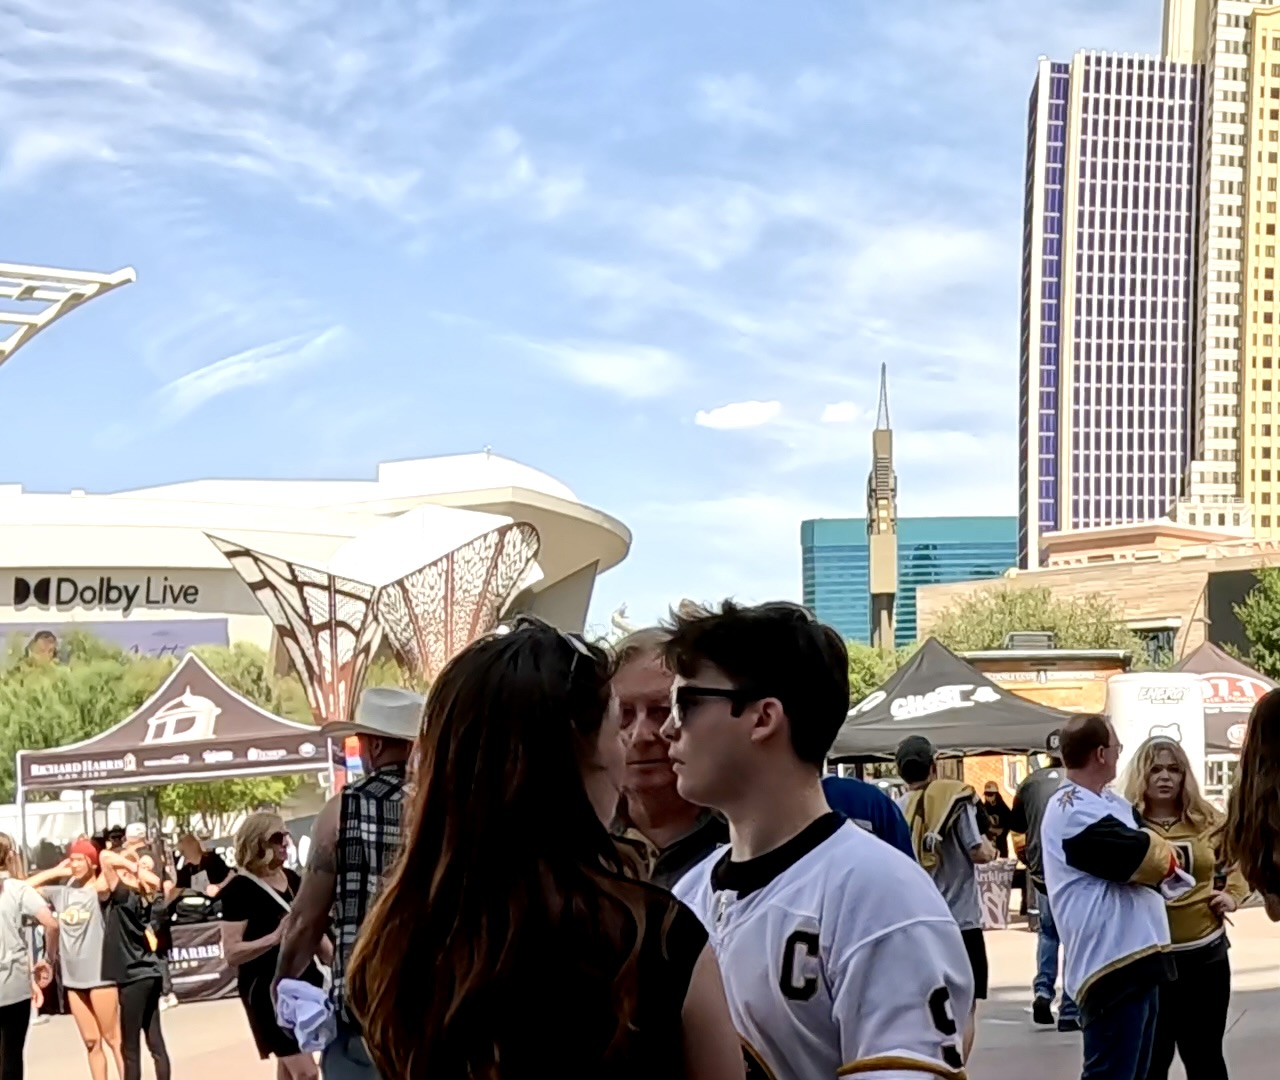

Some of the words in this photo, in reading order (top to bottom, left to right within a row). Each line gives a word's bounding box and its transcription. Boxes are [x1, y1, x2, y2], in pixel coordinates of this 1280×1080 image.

[56, 576, 140, 612] Dolby
[145, 576, 199, 605] Live
[30, 760, 82, 777] RICHARD
[81, 757, 124, 772] HARRIS
[171, 942, 220, 962] HARRIS
[779, 929, 820, 1002] C
